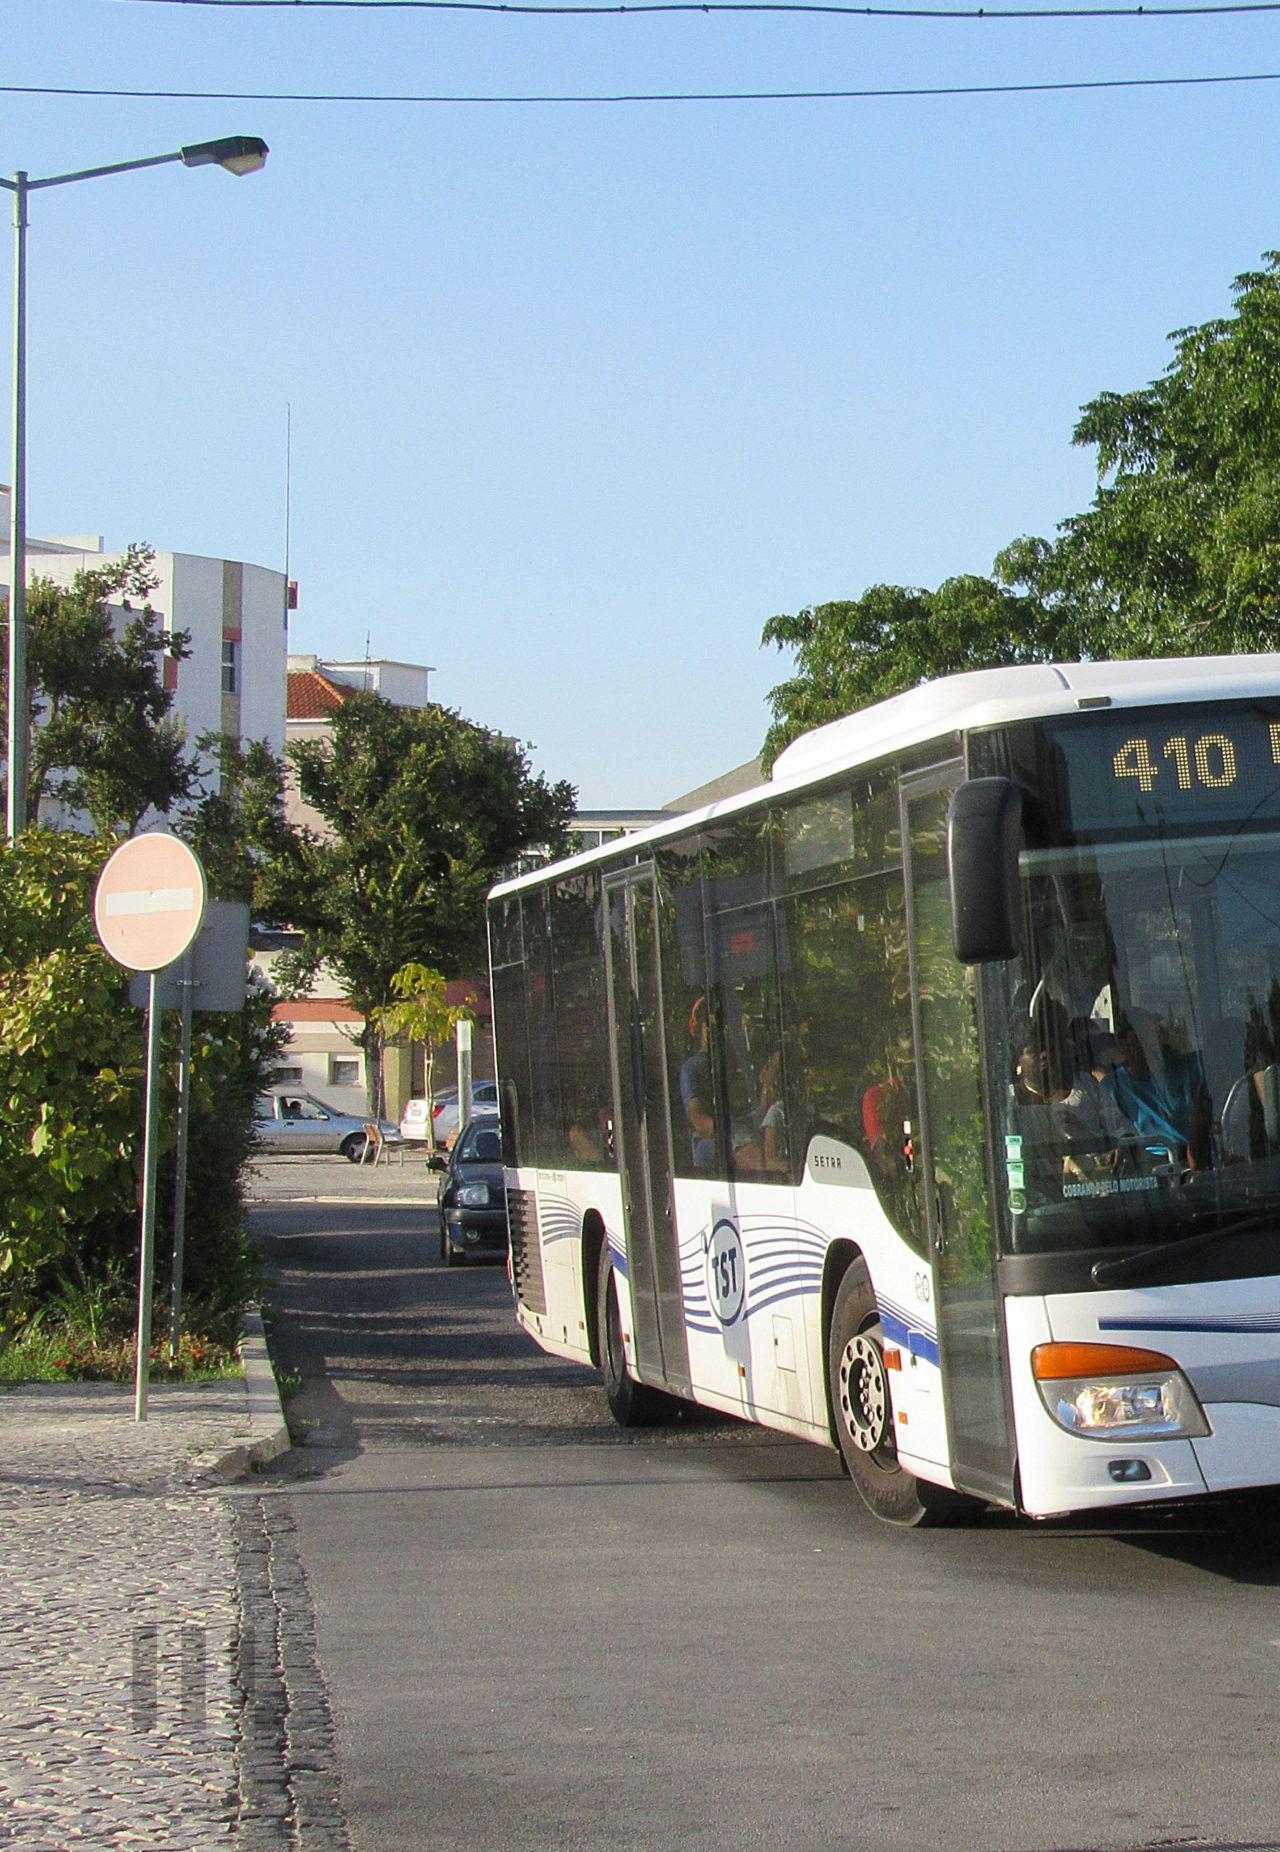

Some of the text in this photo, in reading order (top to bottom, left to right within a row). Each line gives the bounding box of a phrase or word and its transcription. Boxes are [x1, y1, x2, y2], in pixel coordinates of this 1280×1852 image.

[1112, 735, 1237, 792] 410
[814, 1155, 842, 1169] SETRA
[712, 1247, 737, 1300] TST
